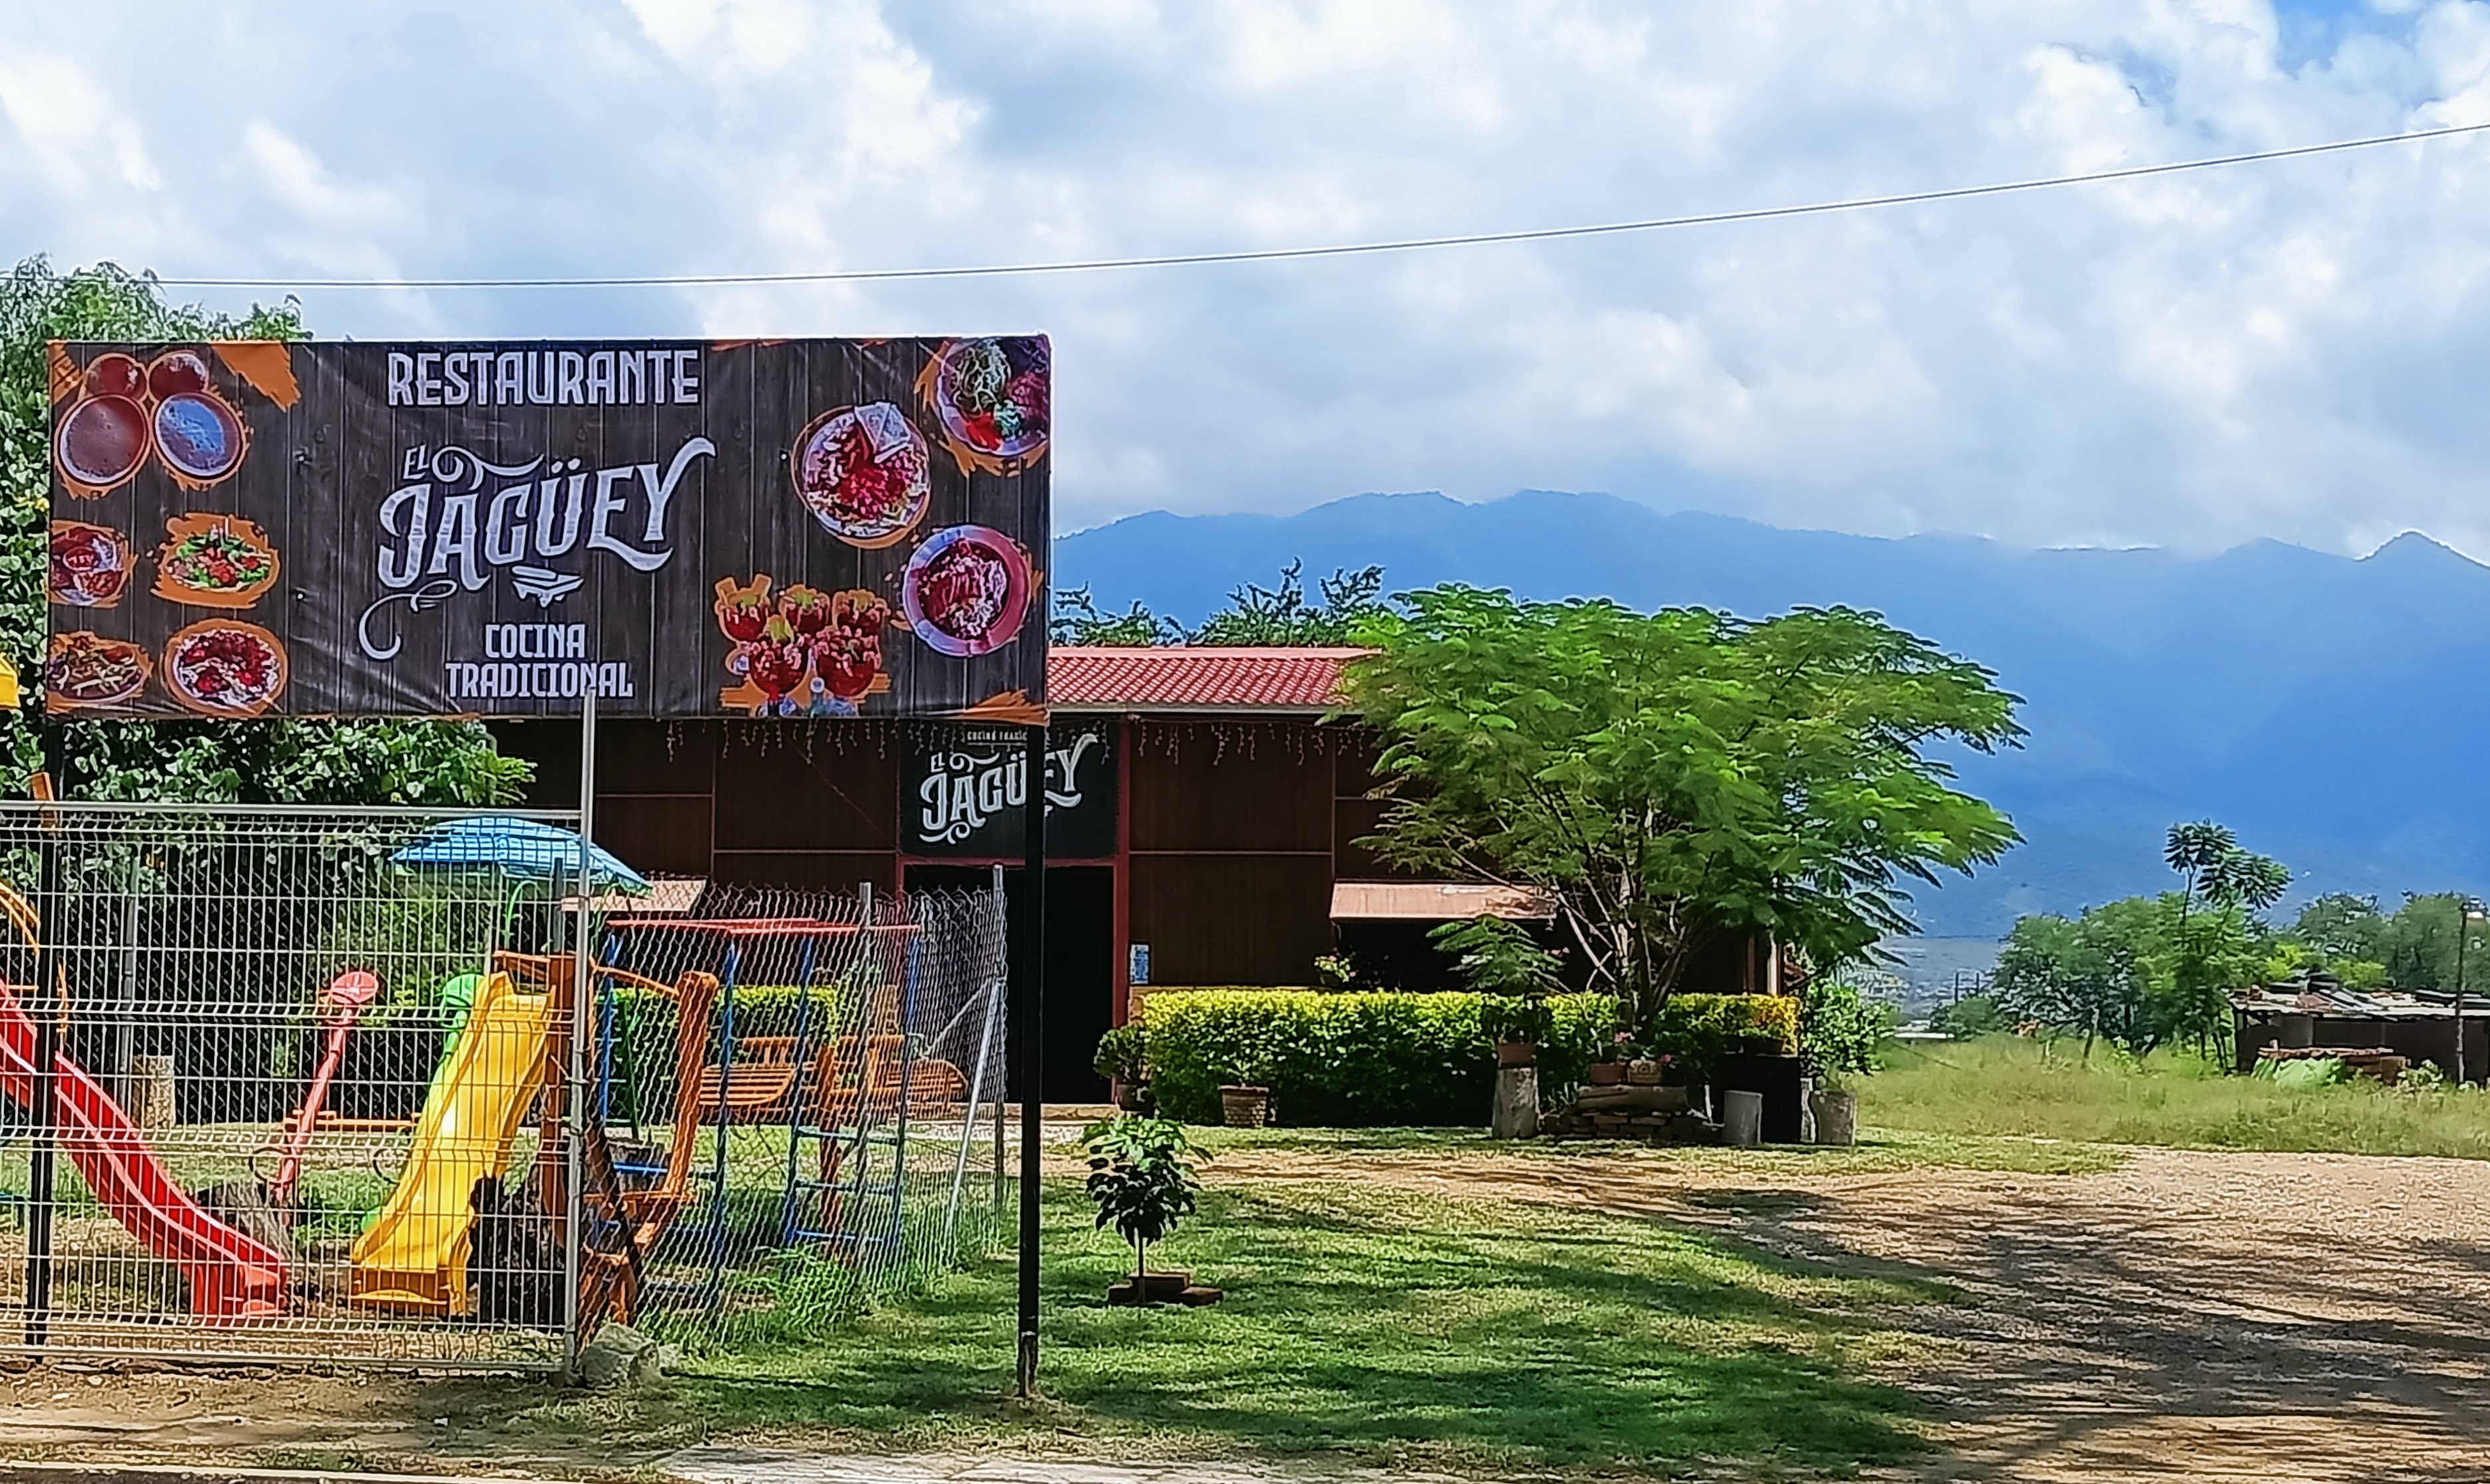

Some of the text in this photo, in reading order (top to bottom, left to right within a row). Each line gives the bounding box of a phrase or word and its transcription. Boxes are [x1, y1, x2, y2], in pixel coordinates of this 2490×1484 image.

[388, 350, 699, 406] RESTAURANTE
[403, 444, 431, 479] EL
[378, 436, 717, 591] JAGÜEY
[485, 624, 586, 658] COCINA
[445, 662, 633, 697] TRADICIONAL
[931, 752, 945, 772] EL
